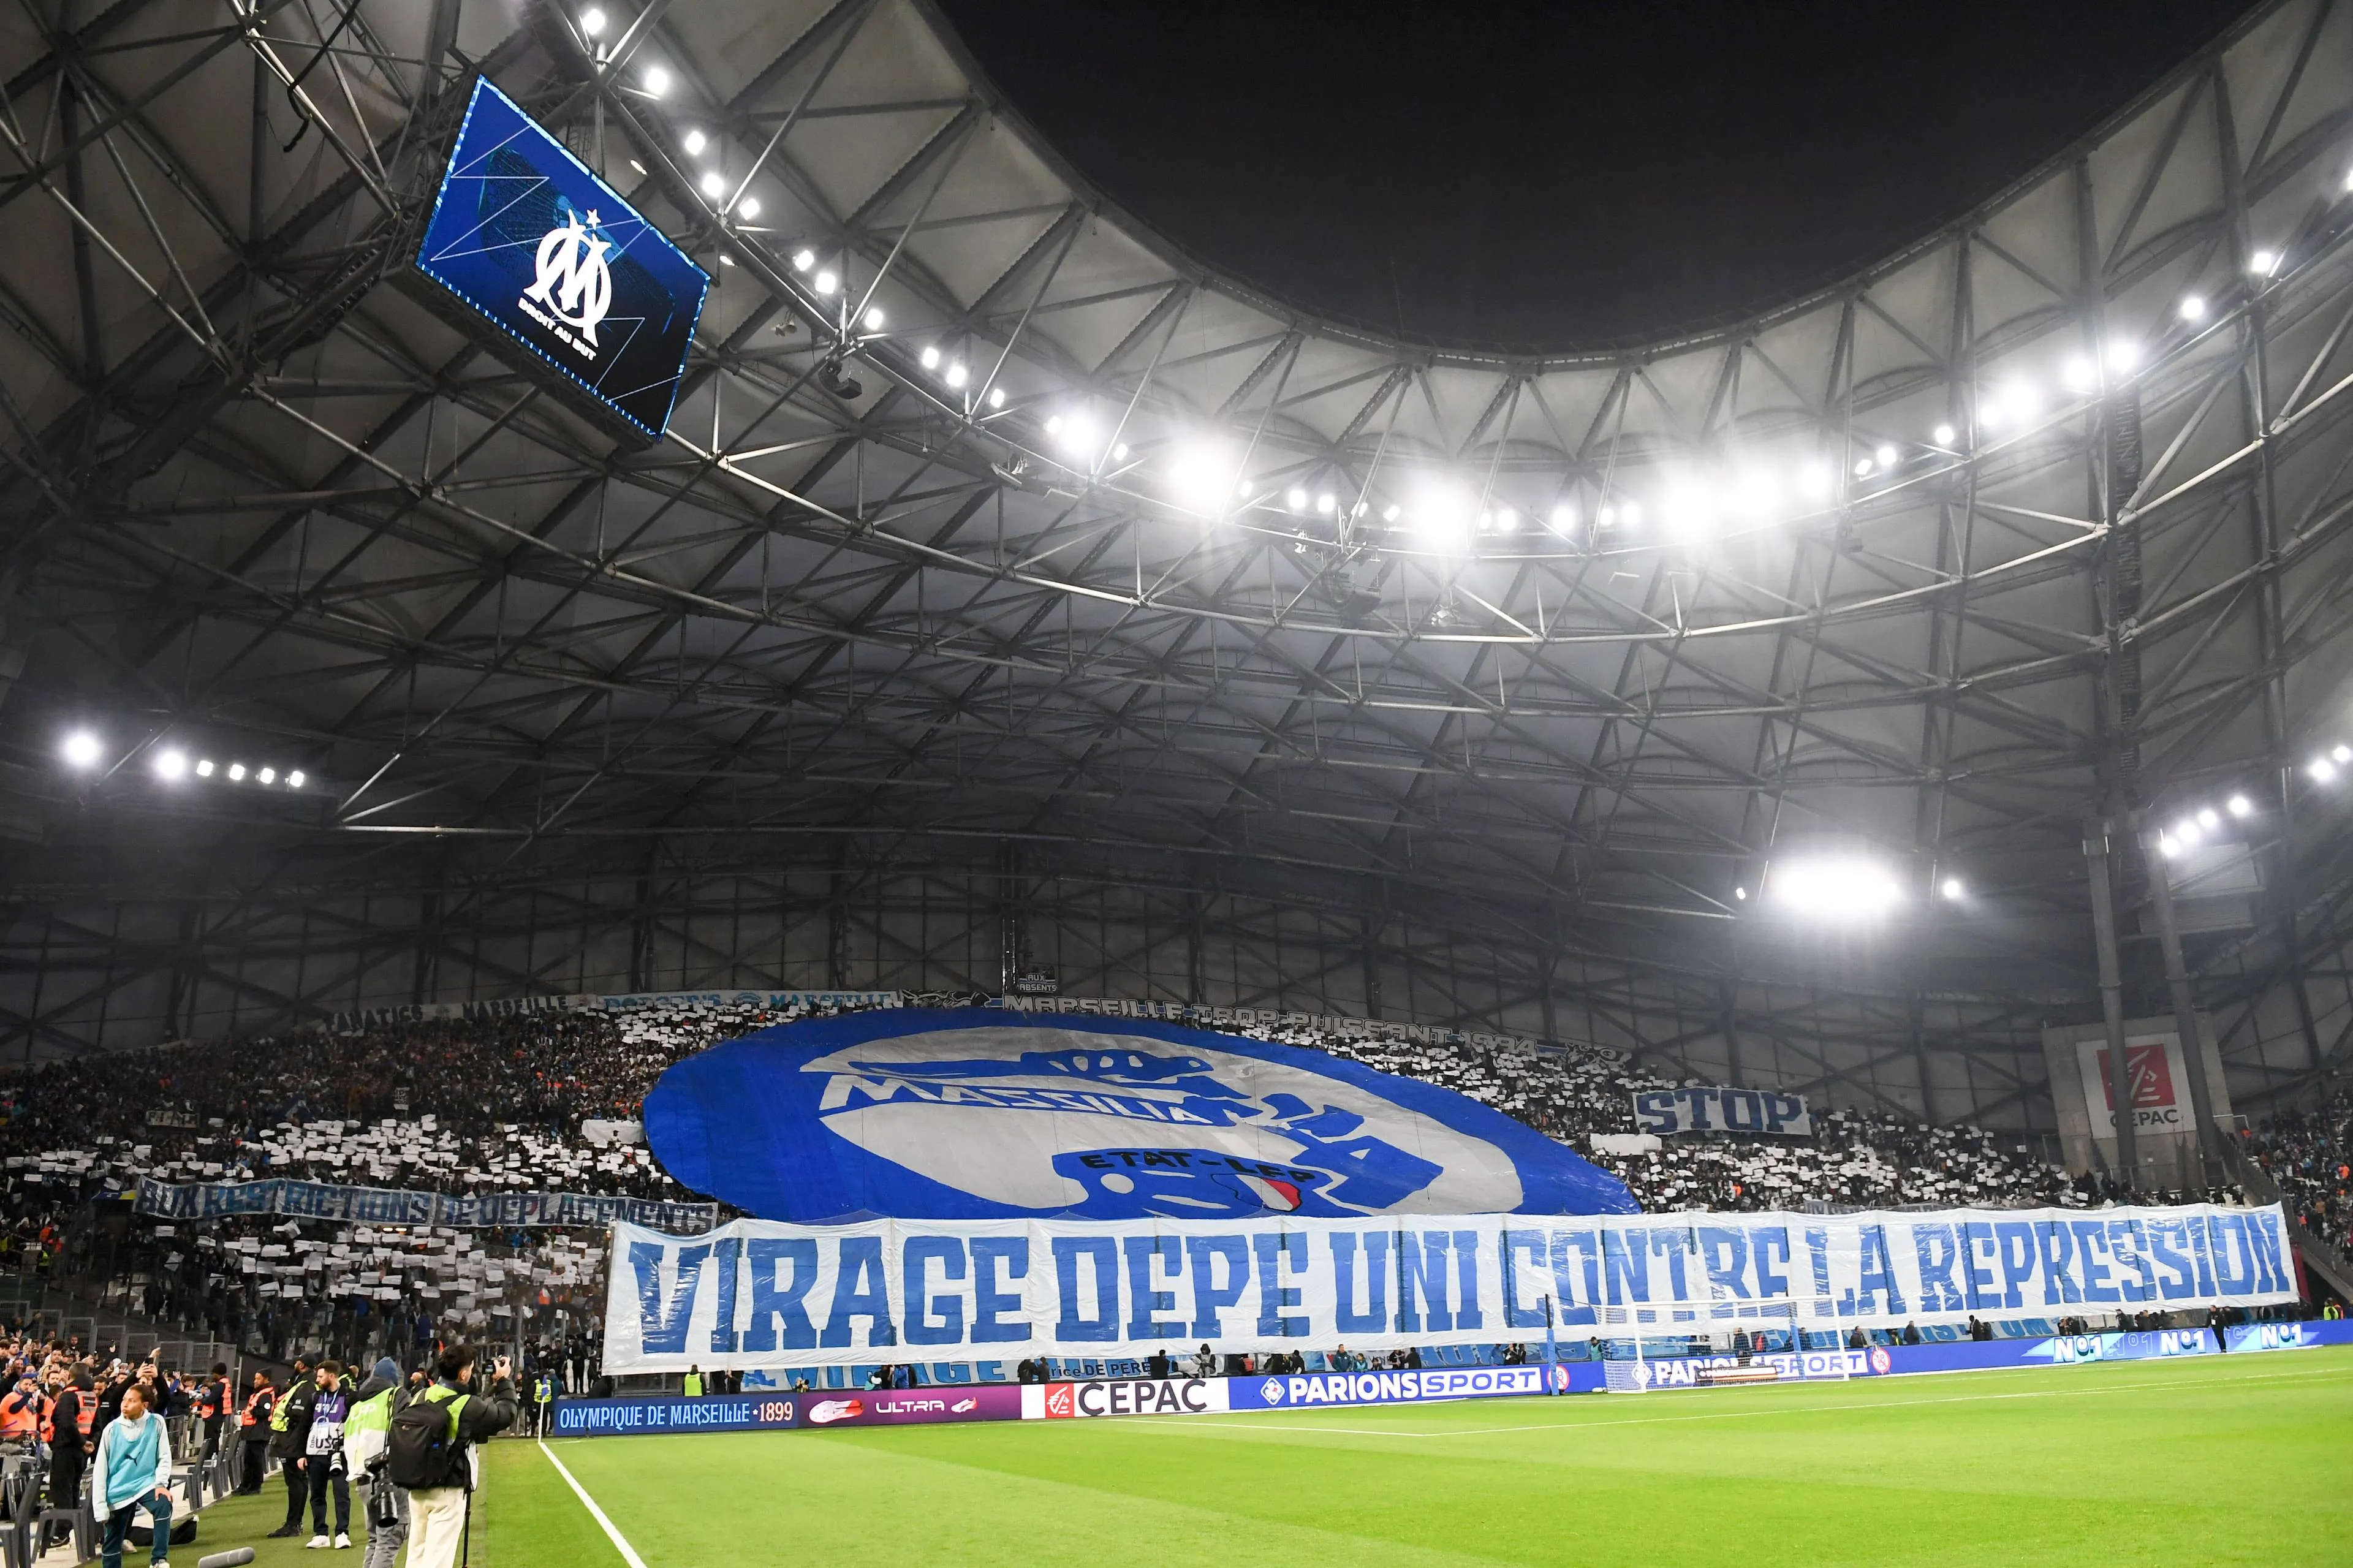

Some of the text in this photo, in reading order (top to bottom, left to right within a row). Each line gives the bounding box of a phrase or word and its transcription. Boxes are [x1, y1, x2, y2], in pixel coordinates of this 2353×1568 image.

[518, 297, 597, 360] DROIT AU BUT
[1020, 983, 1057, 992] ABSENTS
[324, 1005, 423, 1032] FANATICS
[462, 996, 568, 1022] MARSEILLE
[1003, 994, 1537, 1056] MARSEILLE TROP PUISSANT 1994
[819, 1074, 1214, 1124] MASSILIA
[1636, 1087, 1803, 1133] STOP
[136, 1180, 197, 1218] AUX
[477, 1192, 714, 1233] DEPLACEMENTS
[629, 1213, 2290, 1354] VIRAGE DEPE UNI CONTRE LA REPRESSION
[1085, 1364, 1105, 1375] DE
[1289, 1371, 1537, 1404] PARIONS SPORT
[876, 1399, 945, 1414] ULTRA
[1078, 1378, 1207, 1417] CEPAC
[559, 1401, 794, 1431] OLYMPIQUE DE MARSEILLE 1899
